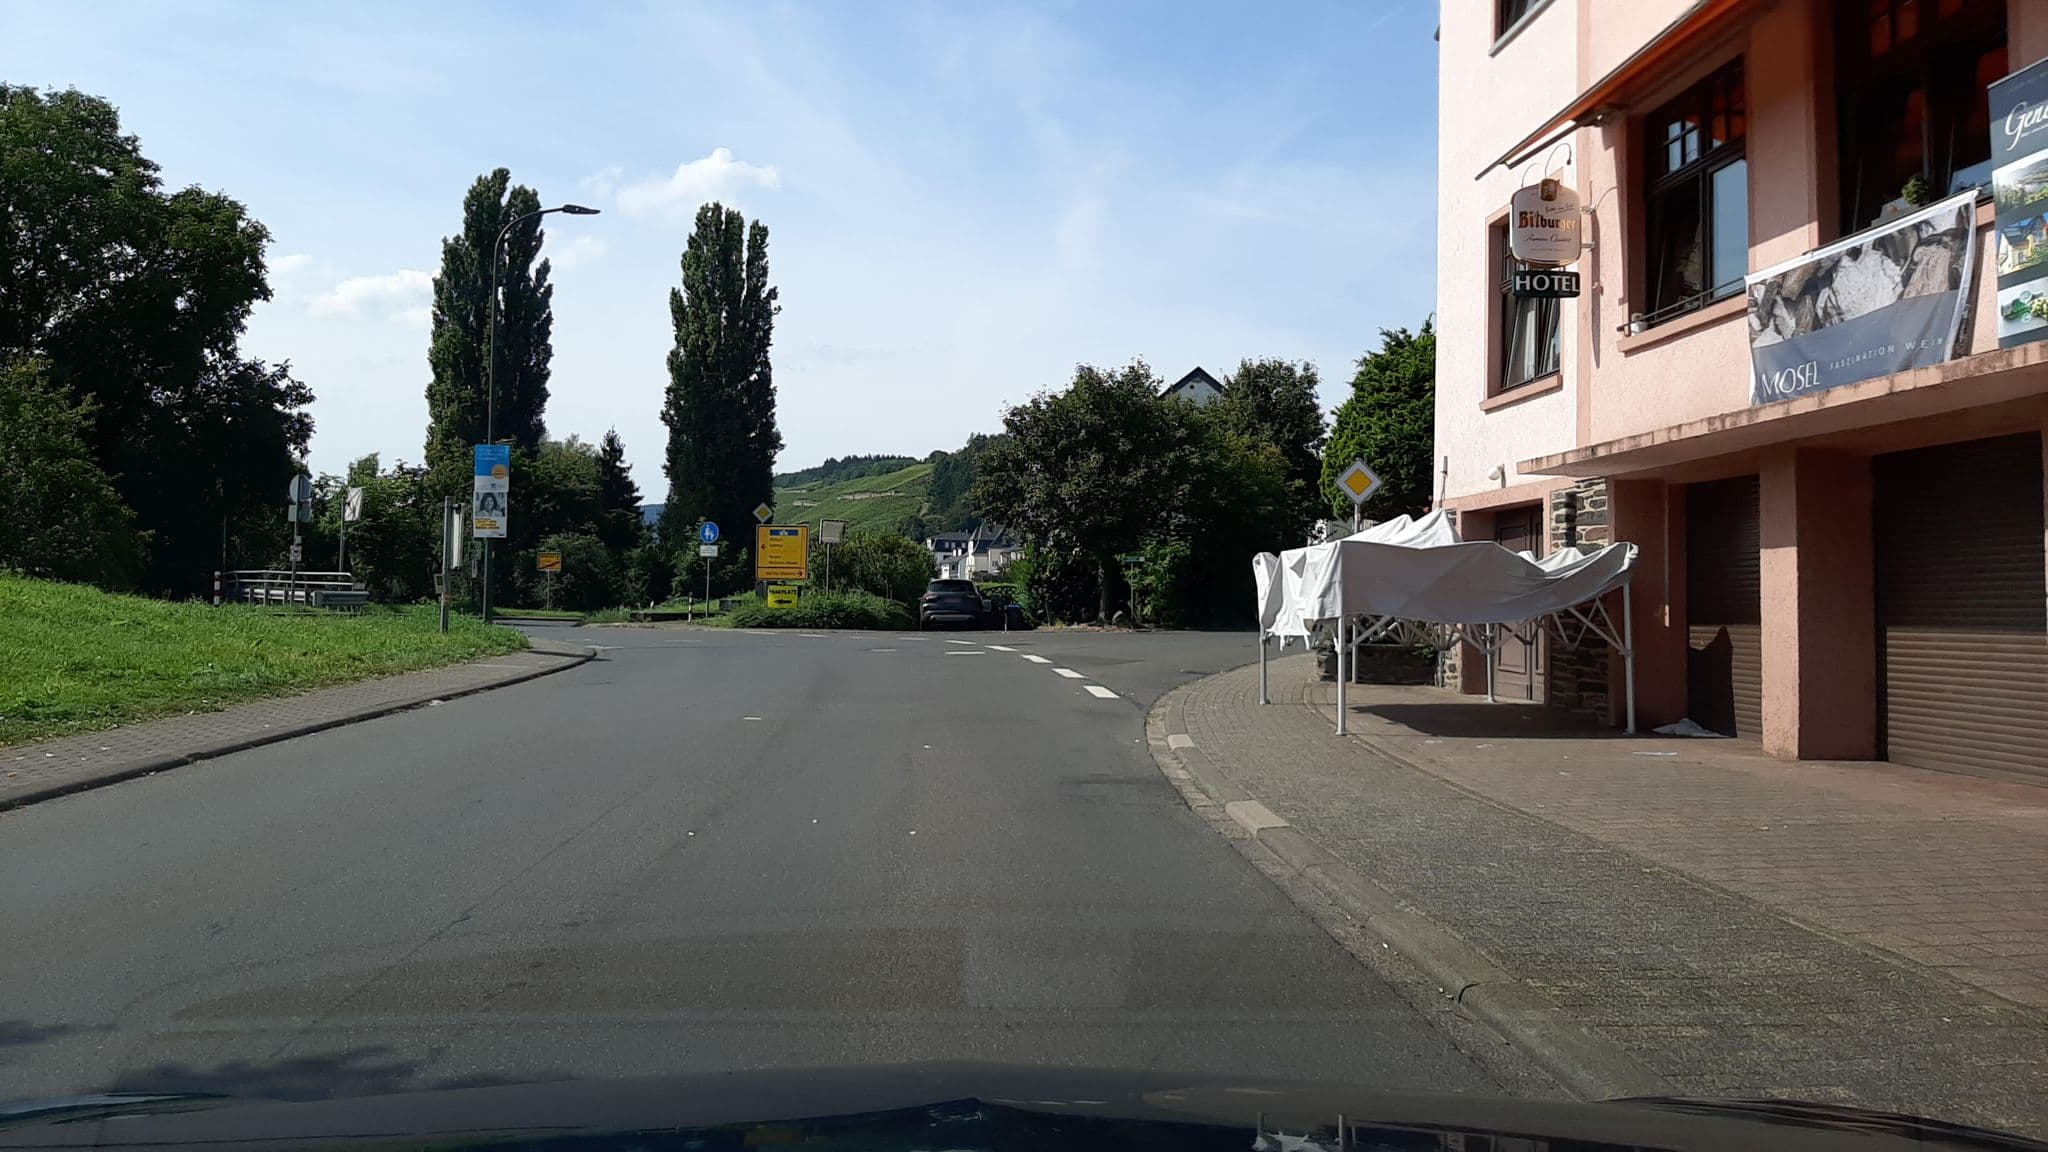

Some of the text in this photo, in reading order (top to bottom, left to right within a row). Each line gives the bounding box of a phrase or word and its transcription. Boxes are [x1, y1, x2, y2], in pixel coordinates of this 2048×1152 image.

[1518, 210, 1576, 231] Bitburger
[1515, 275, 1579, 292] HOTEL
[1762, 361, 1820, 396] MOSEL
[1905, 338, 1943, 350] WEIN
